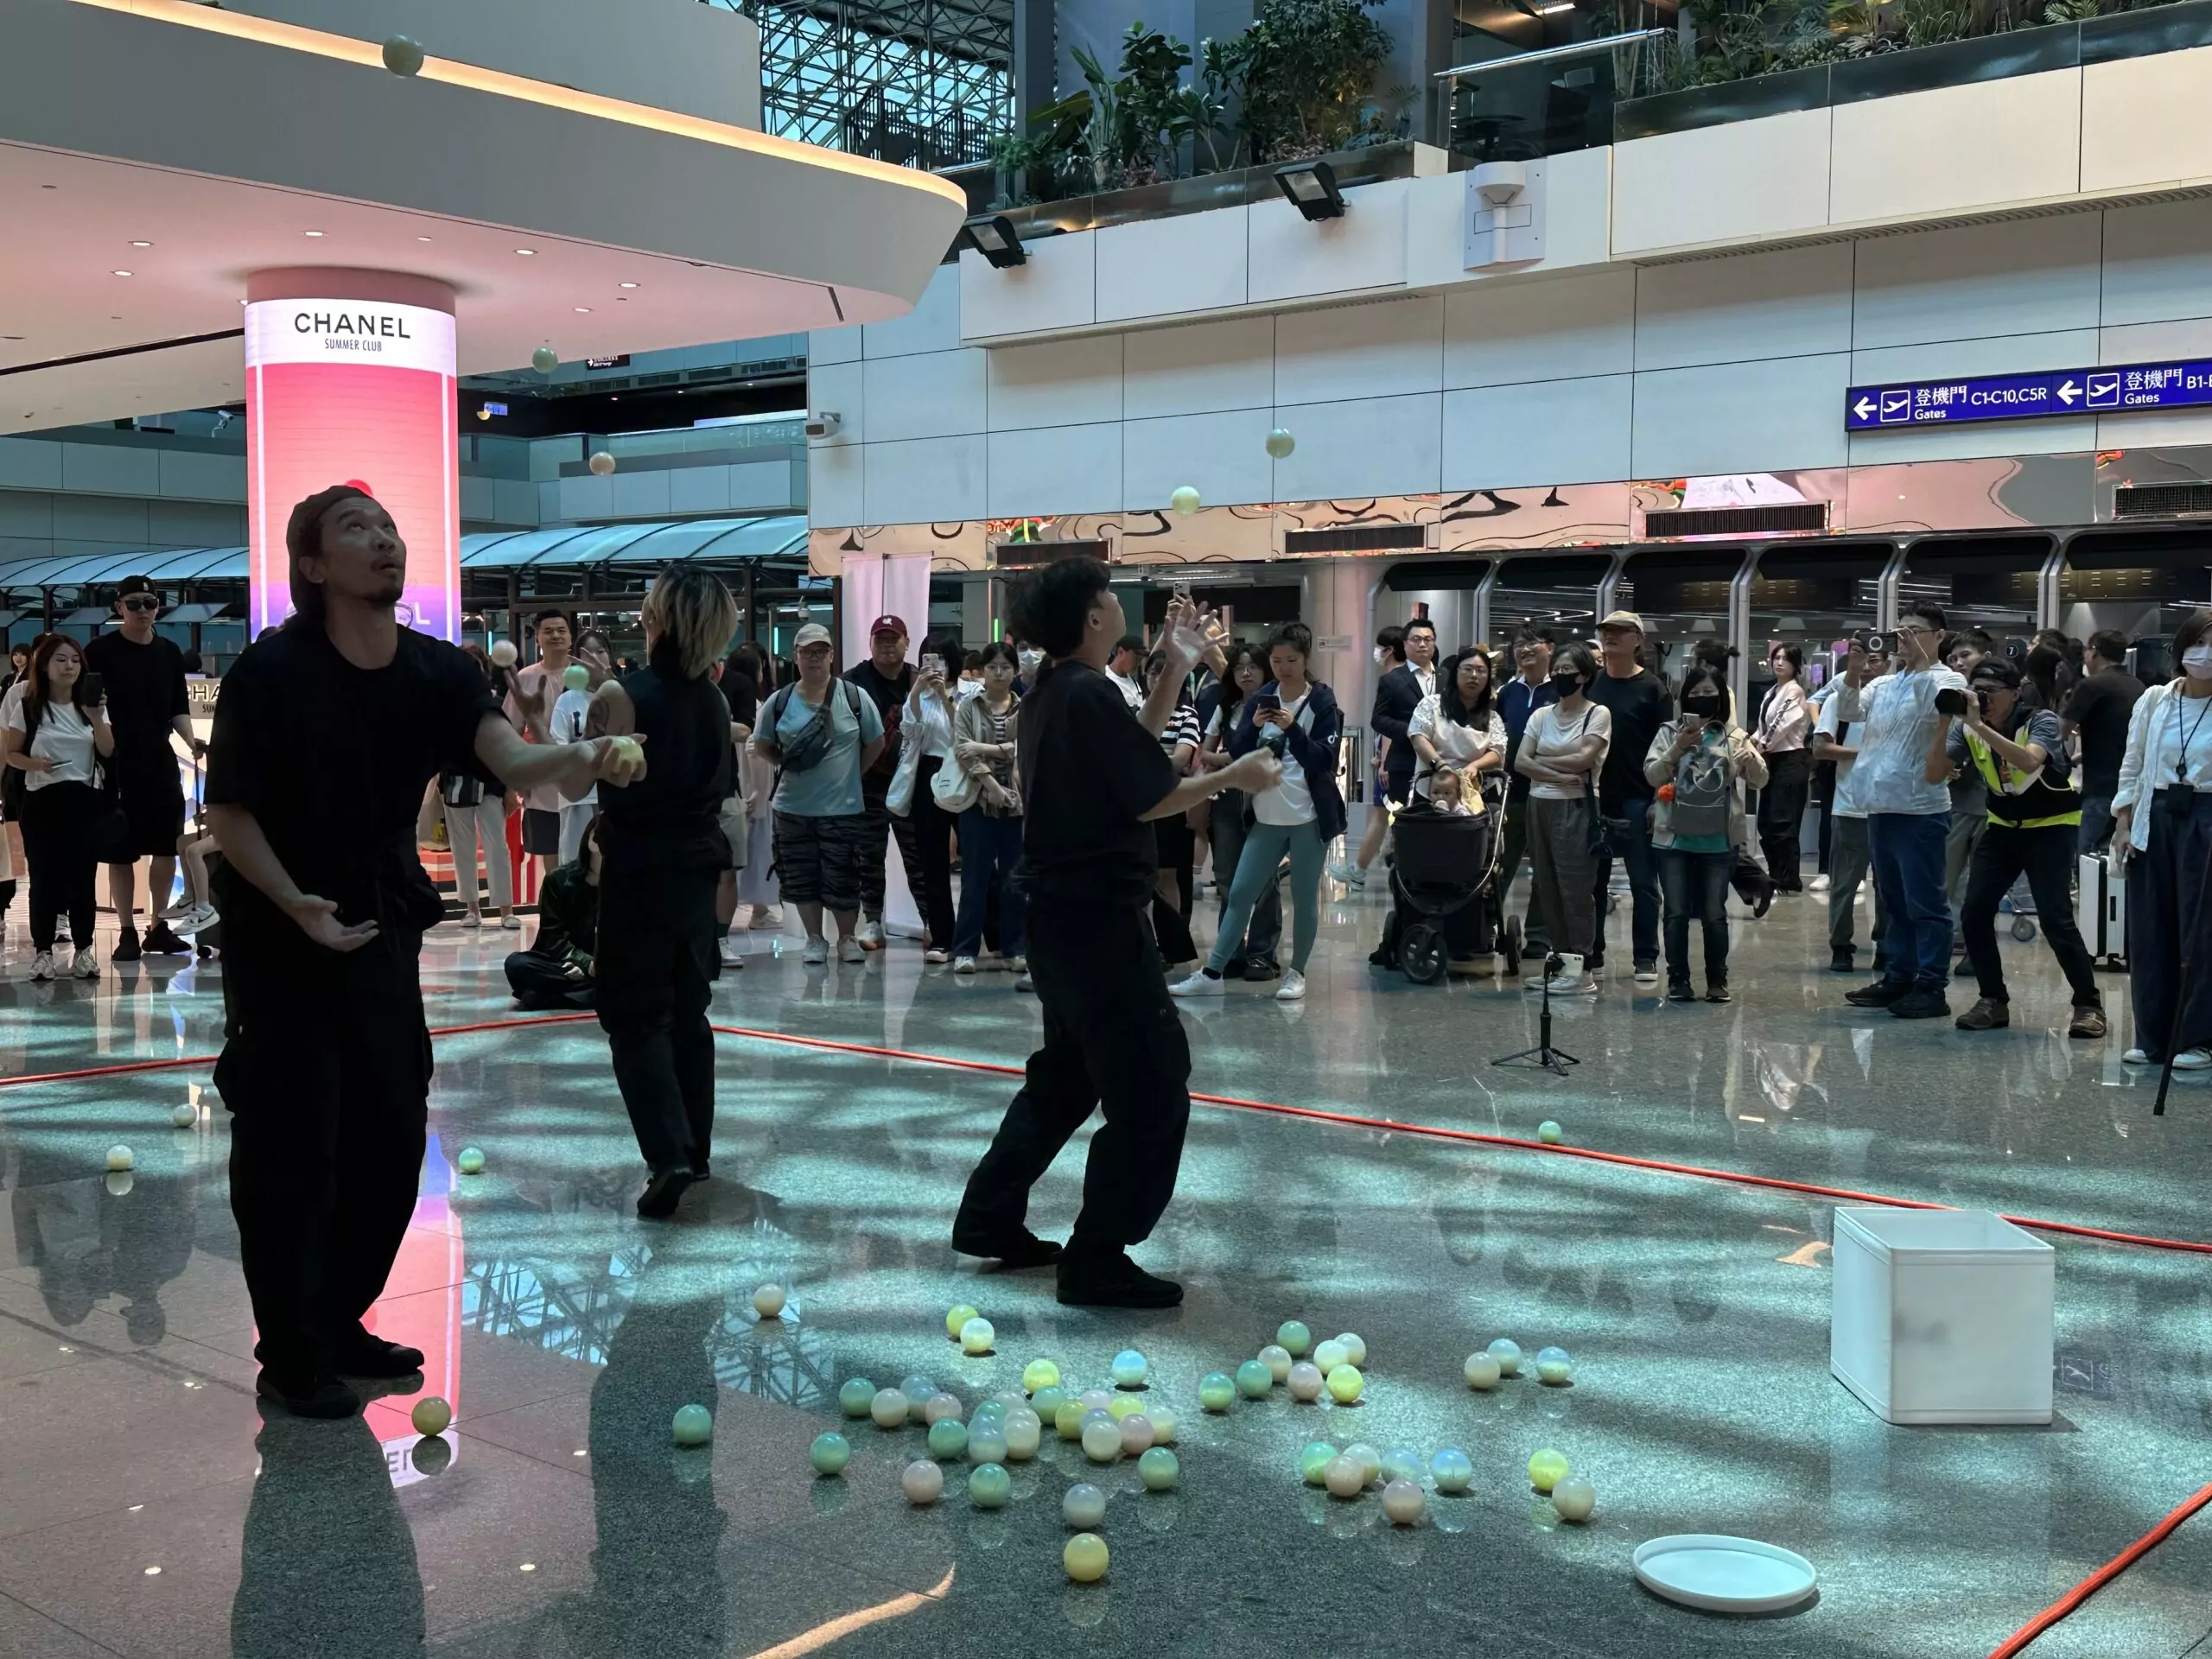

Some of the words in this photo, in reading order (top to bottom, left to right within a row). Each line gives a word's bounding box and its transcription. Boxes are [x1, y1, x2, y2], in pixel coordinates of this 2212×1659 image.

[295, 313, 410, 339] CHANEL
[325, 339, 359, 351] SUMMER
[362, 340, 382, 352] CLUB
[2125, 368, 2183, 391] 登機門
[1915, 385, 1967, 407] 登機門
[1971, 387, 2047, 405] C1-C10,C5R
[2125, 393, 2159, 404] Gates
[1915, 409, 1947, 420] Gates
